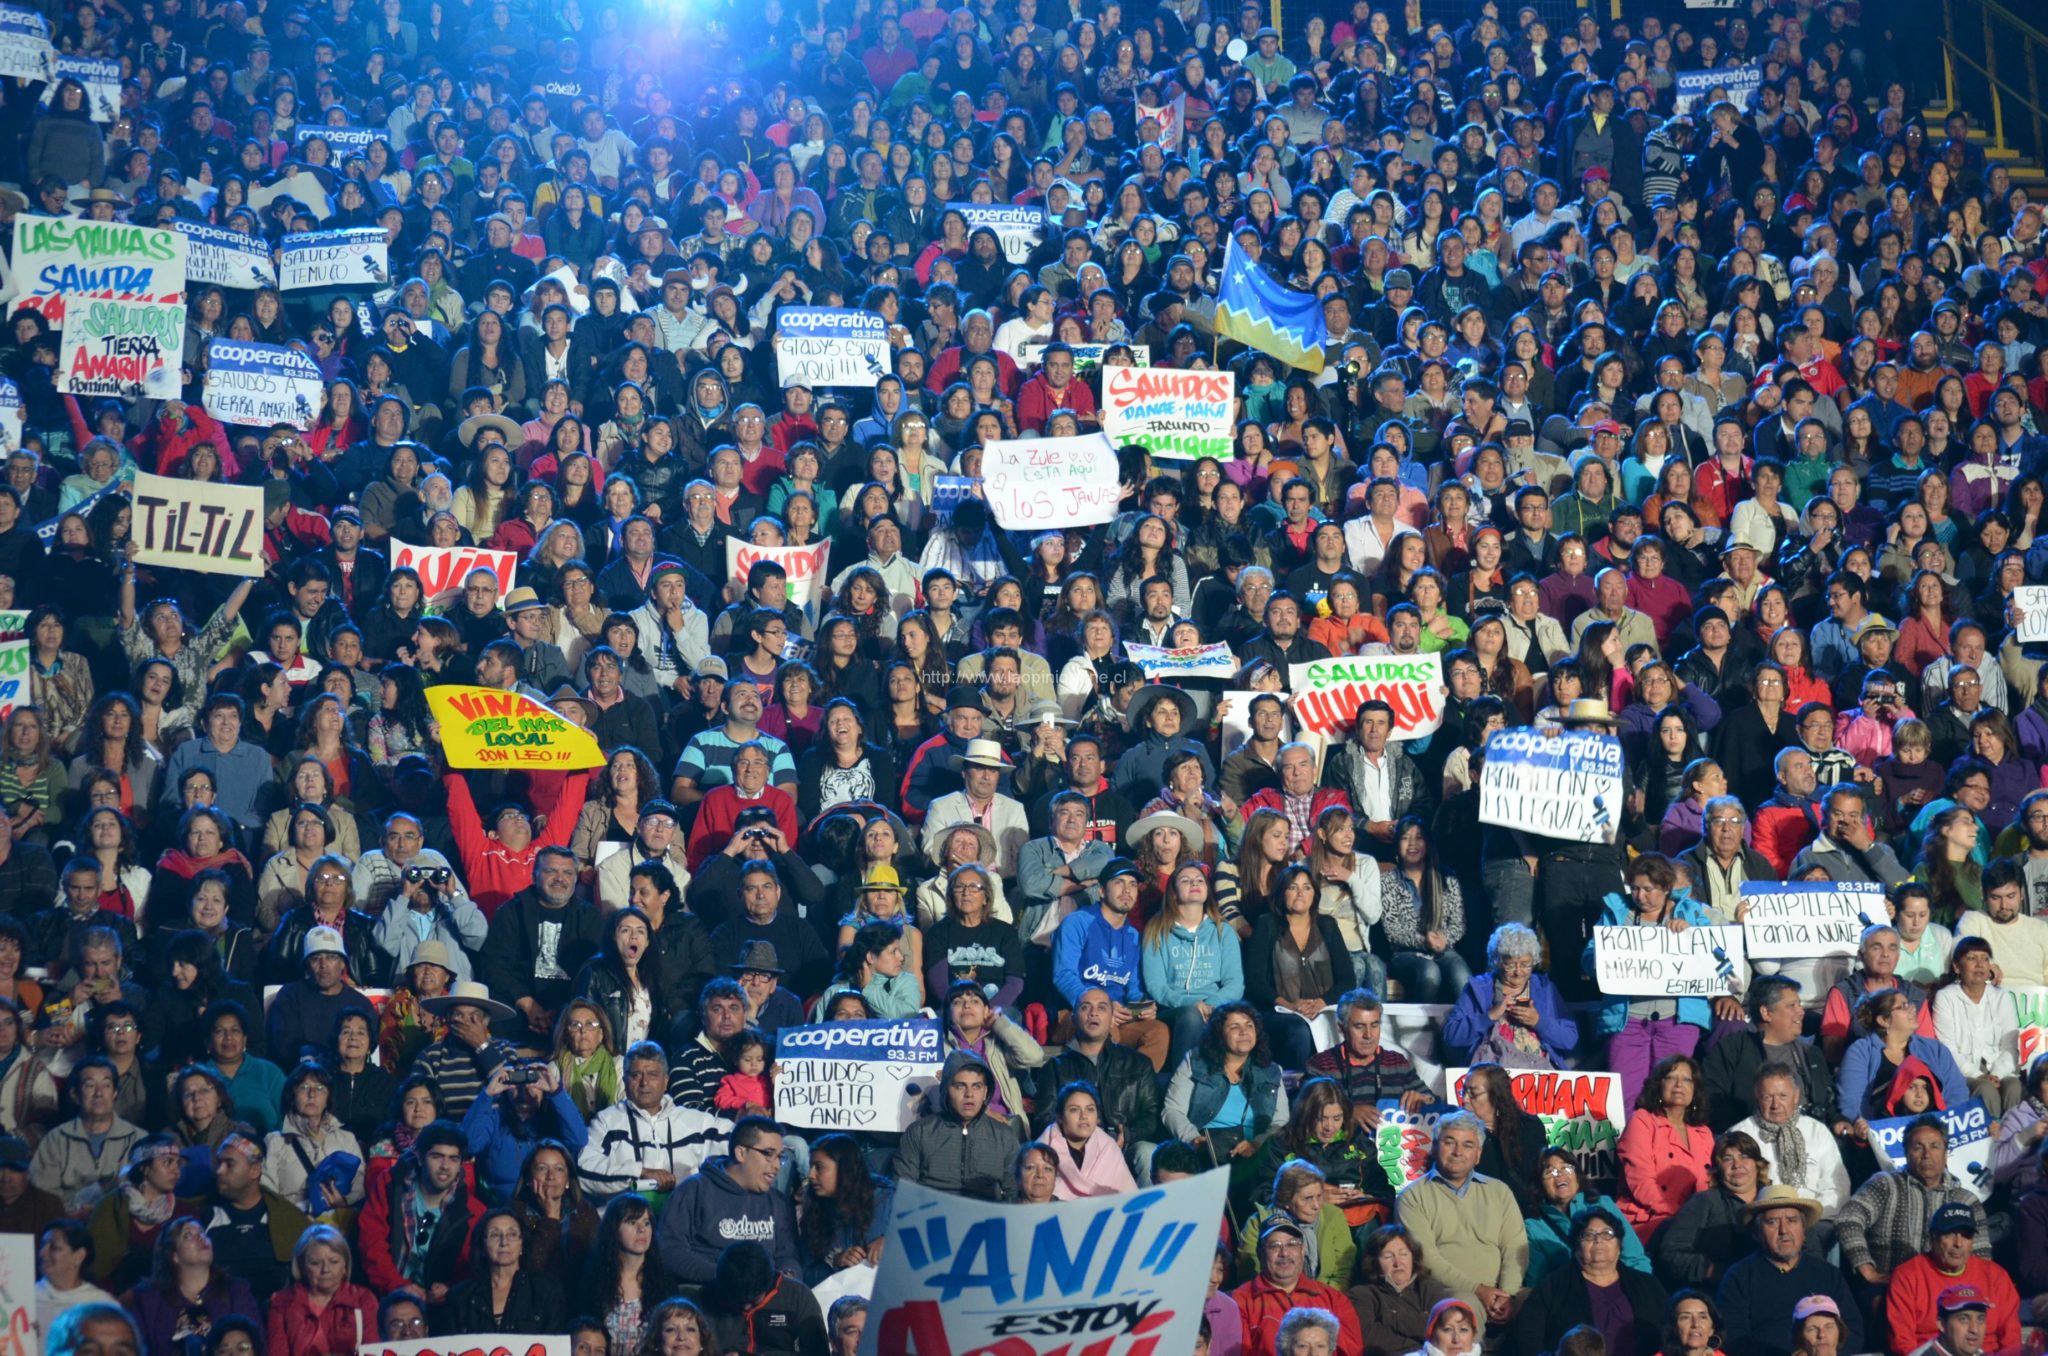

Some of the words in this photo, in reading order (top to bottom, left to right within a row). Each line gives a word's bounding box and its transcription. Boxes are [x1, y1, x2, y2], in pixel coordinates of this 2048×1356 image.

[1679, 68, 1760, 89] cooperativa
[20, 221, 74, 254] LAS
[175, 221, 269, 250] cooperativa
[284, 246, 349, 268] SALUDOS
[83, 302, 184, 350] SALUDOS
[780, 311, 885, 331] cooperativa
[851, 330, 871, 338] 93.3
[872, 330, 885, 339] FM
[102, 335, 161, 361] TIERRA
[210, 344, 320, 370] cooperativa
[283, 368, 303, 378] 93.3
[305, 370, 319, 380] FM
[284, 377, 298, 394] A
[1109, 368, 1230, 408] SALUDOS
[1146, 420, 1210, 433] FACUNDO
[1307, 662, 1435, 688] SALUDOS
[465, 717, 514, 736] DEL
[518, 718, 568, 733] MAR
[485, 732, 554, 746] LOCAL
[1490, 732, 1621, 763] cooperativa
[475, 749, 509, 762] DON
[515, 749, 552, 762] LEO
[1582, 761, 1604, 773] 93.3
[1605, 764, 1620, 776] FM
[1837, 882, 1863, 892] 93.3
[1864, 882, 1881, 893] FM
[1818, 919, 1860, 945] NUÑE
[783, 1022, 938, 1050] cooperativa
[887, 1049, 916, 1060] 93.3
[918, 1051, 938, 1062] FM
[781, 1061, 875, 1085] SALUDOS
[810, 1107, 851, 1126] ANA
[1971, 1127, 1989, 1142] FM
[986, 1299, 1161, 1337] ESTOY
